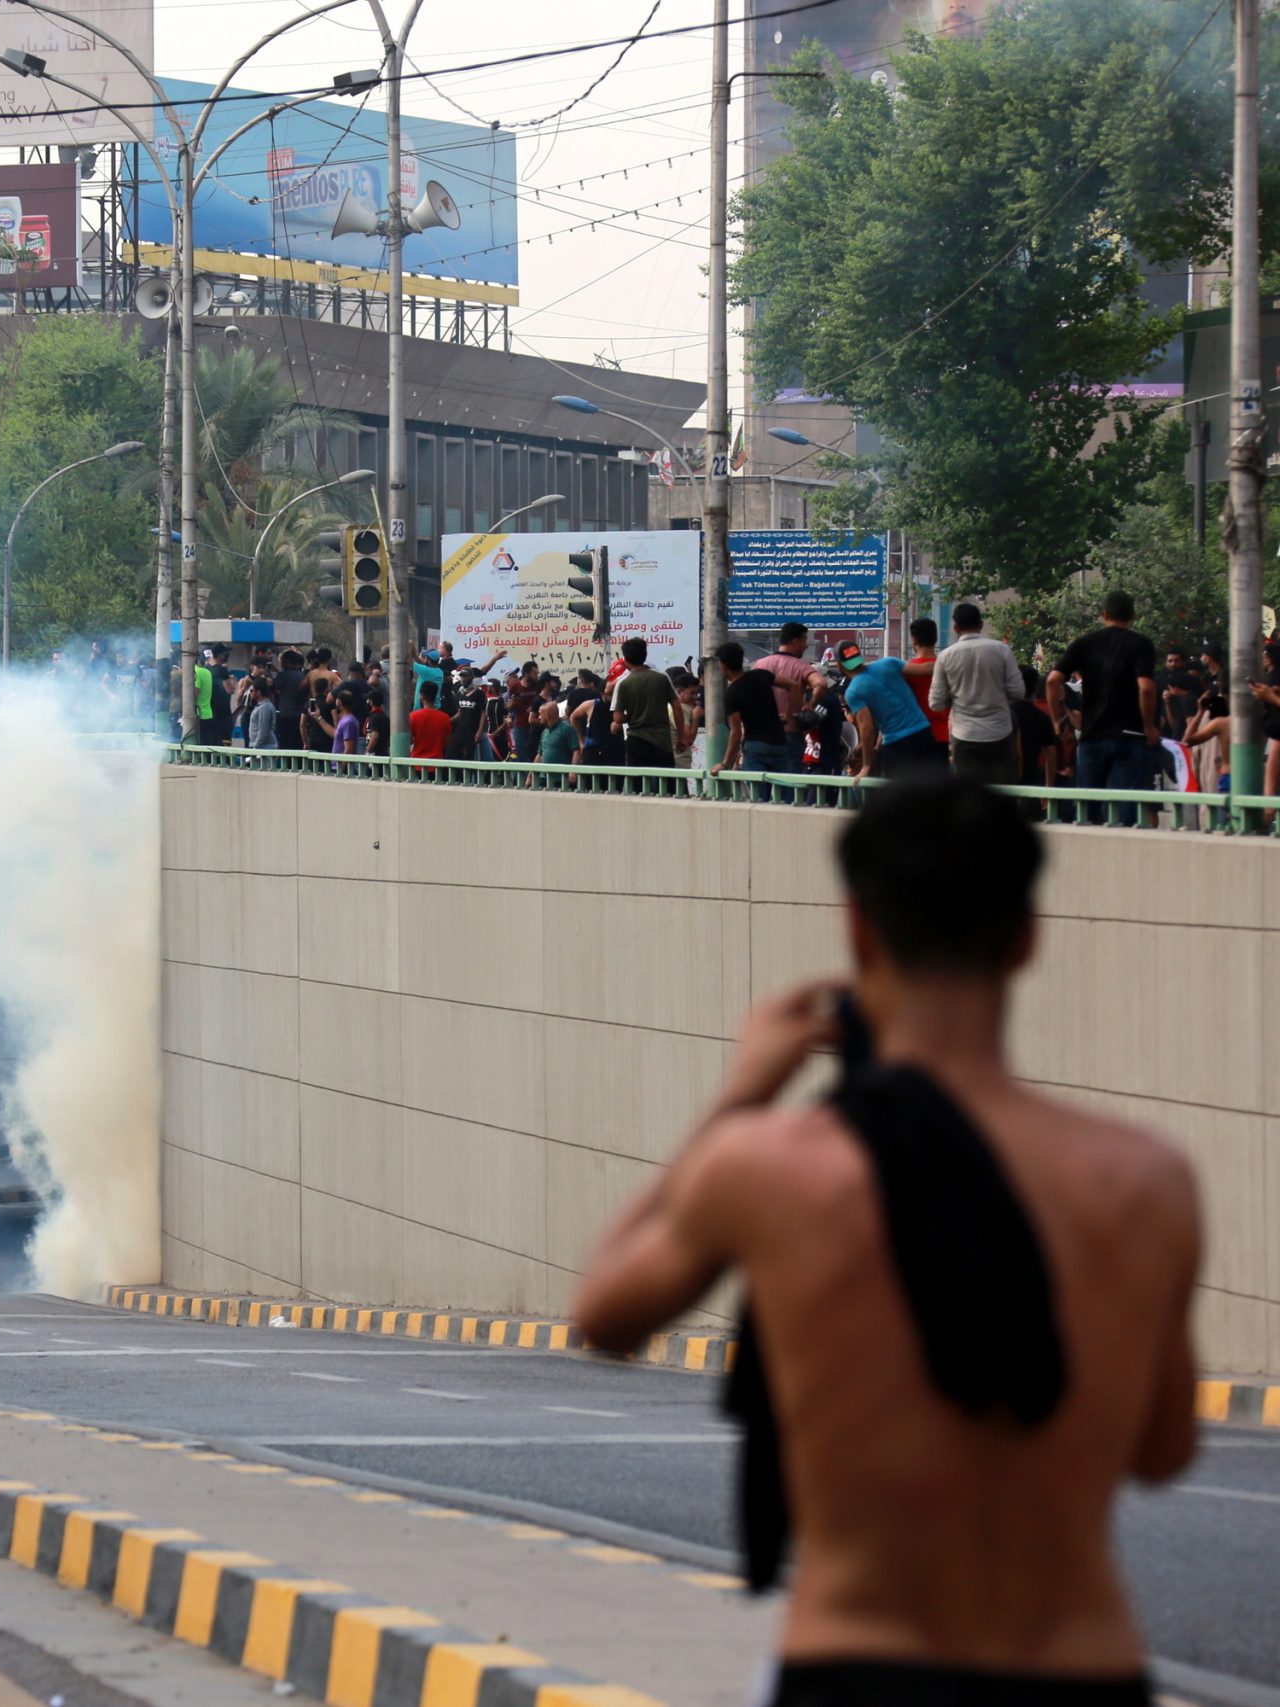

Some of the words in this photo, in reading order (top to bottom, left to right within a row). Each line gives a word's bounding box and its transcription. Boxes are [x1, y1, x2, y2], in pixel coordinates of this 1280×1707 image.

[41, 99, 64, 124] A
[274, 172, 339, 210] mentos
[713, 456, 727, 476] 22
[392, 521, 404, 538] 23
[184, 545, 195, 558] 24
[531, 601, 552, 611] شركة
[554, 603, 564, 611] مع
[633, 600, 655, 608] جامعة
[456, 622, 501, 635] الحكومية
[504, 622, 548, 634] الجامعات
[552, 623, 569, 635] في
[650, 620, 684, 633] ملتقى
[464, 637, 490, 650] الأول
[493, 636, 538, 649] التعليمية
